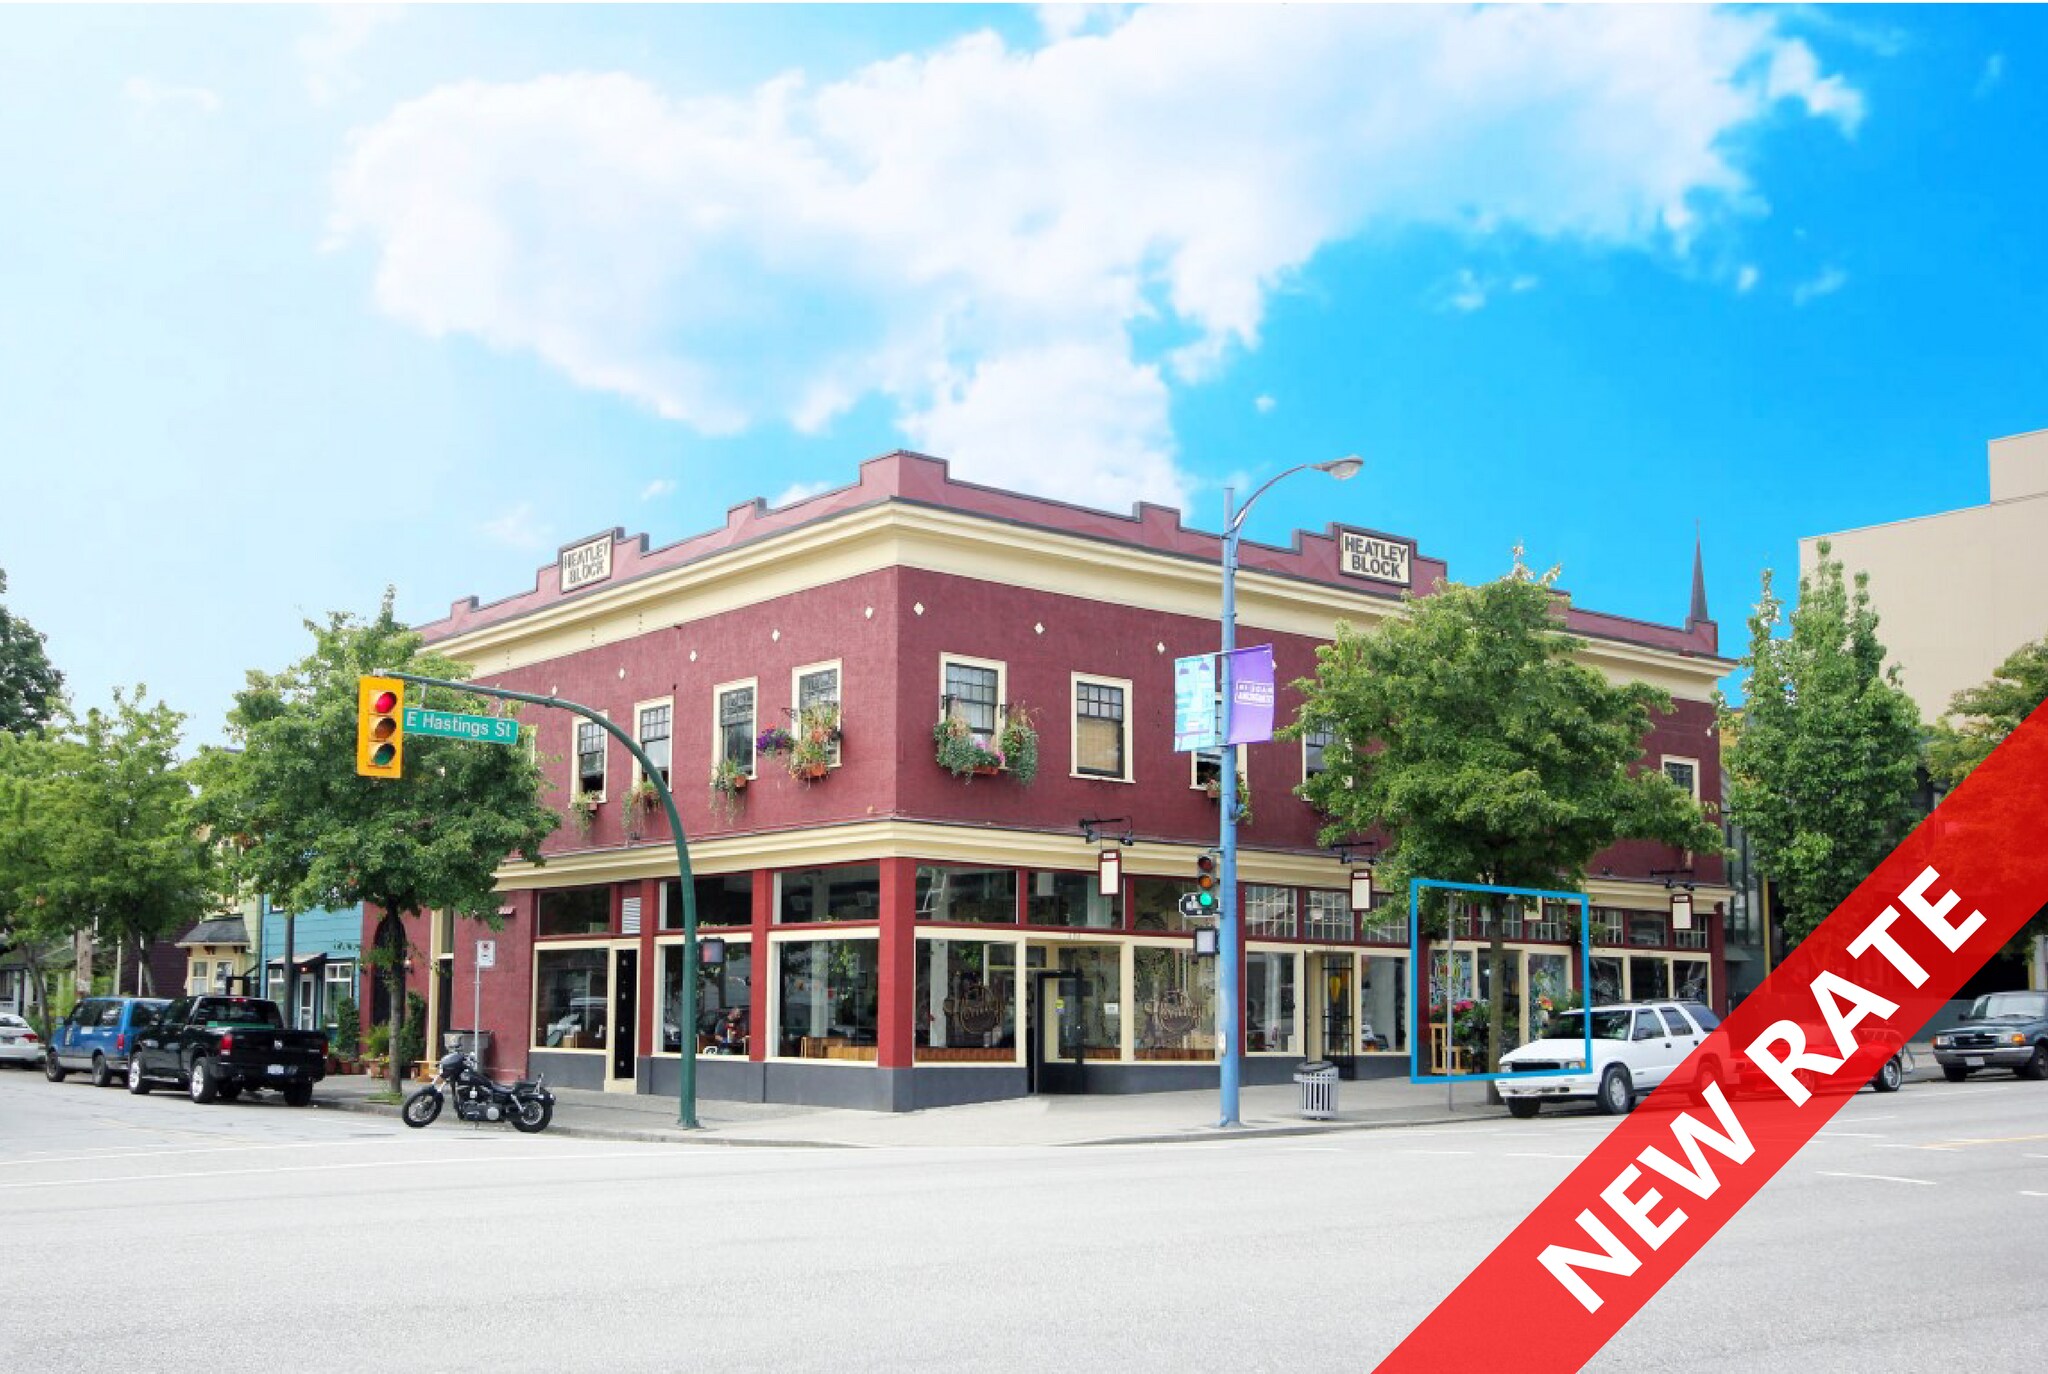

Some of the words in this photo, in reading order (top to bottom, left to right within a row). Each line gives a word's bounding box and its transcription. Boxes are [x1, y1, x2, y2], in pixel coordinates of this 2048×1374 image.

[564, 541, 608, 570] HEATLEY
[1344, 535, 1407, 563] HEATLEY
[568, 560, 604, 584] BLOCK
[1352, 554, 1401, 579] BLOCK
[406, 711, 418, 727] E
[422, 713, 489, 737] Hastings
[495, 722, 511, 737] St
